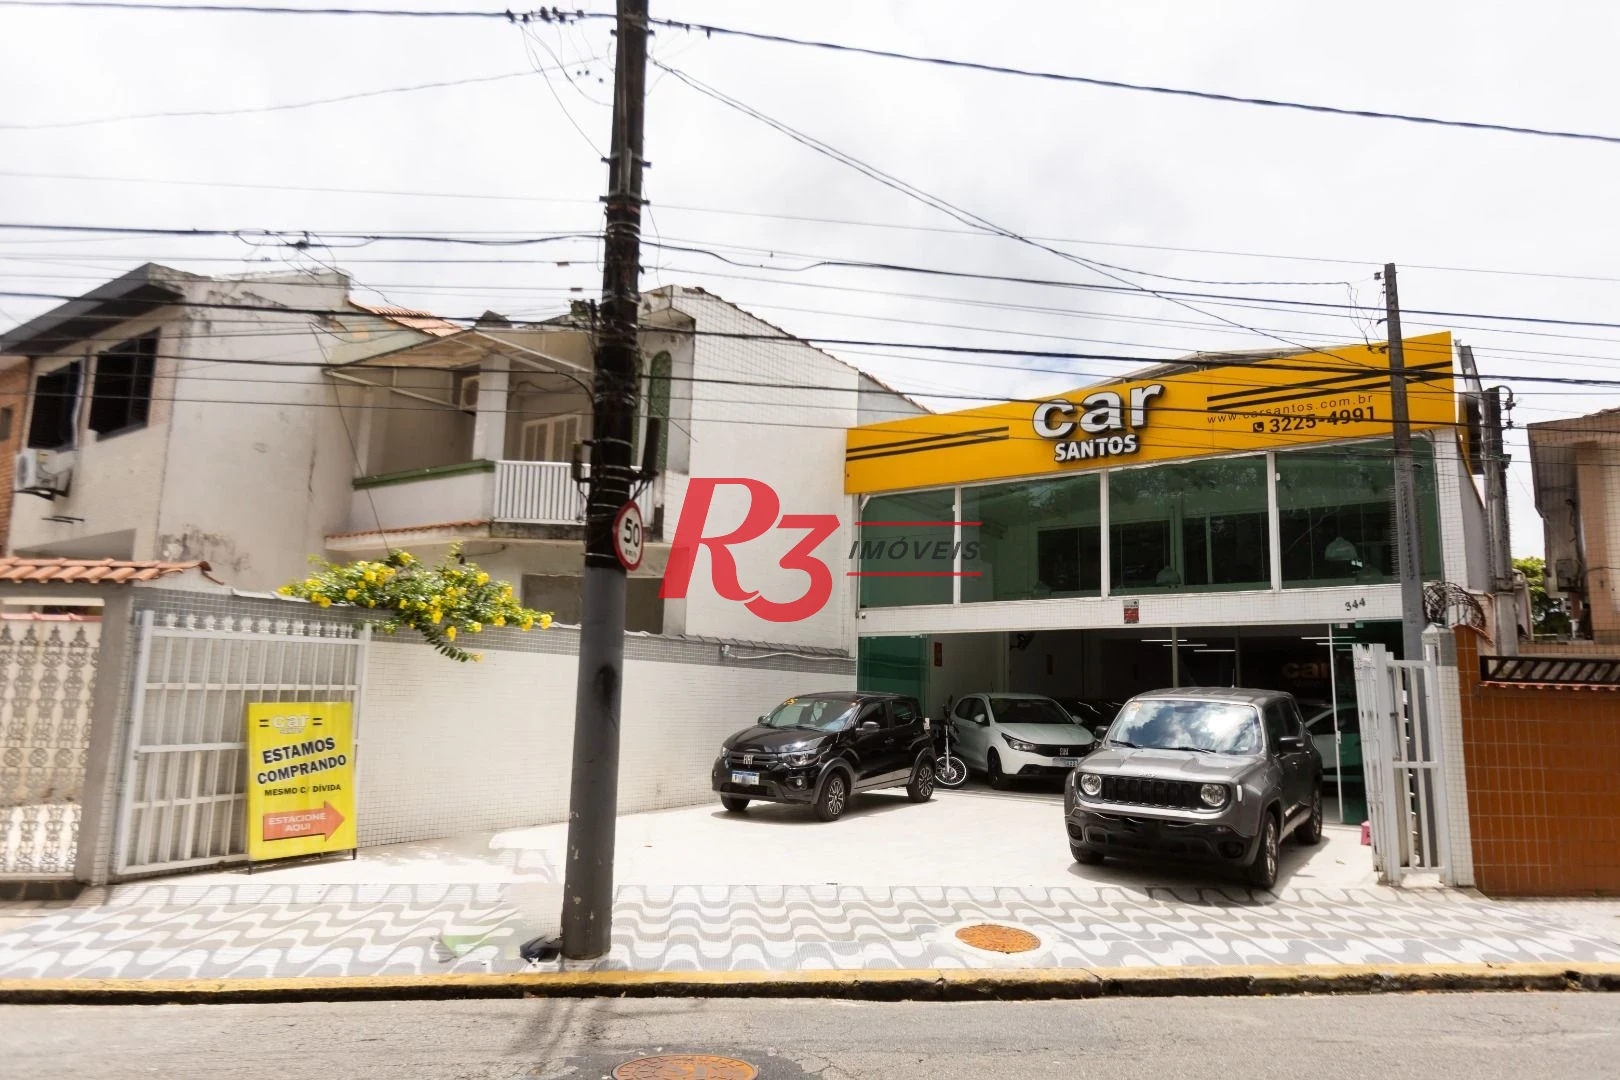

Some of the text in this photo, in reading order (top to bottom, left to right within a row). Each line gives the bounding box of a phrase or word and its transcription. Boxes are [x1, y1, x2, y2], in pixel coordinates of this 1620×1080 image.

[1032, 383, 1165, 438] car
[1207, 394, 1373, 424] www.carsantos.com.br
[1269, 406, 1375, 433] 3225-4991
[1054, 434, 1138, 463] SANTOS
[624, 517, 640, 547] 50
[272, 714, 310, 728] car
[262, 737, 336, 764] ESTAMOS
[257, 754, 347, 784] COMPRANDO
[264, 786, 298, 797] MESMO
[312, 784, 341, 793] DÍVIDA
[268, 812, 327, 825] ESTACIONE
[284, 823, 311, 833] AQUI
